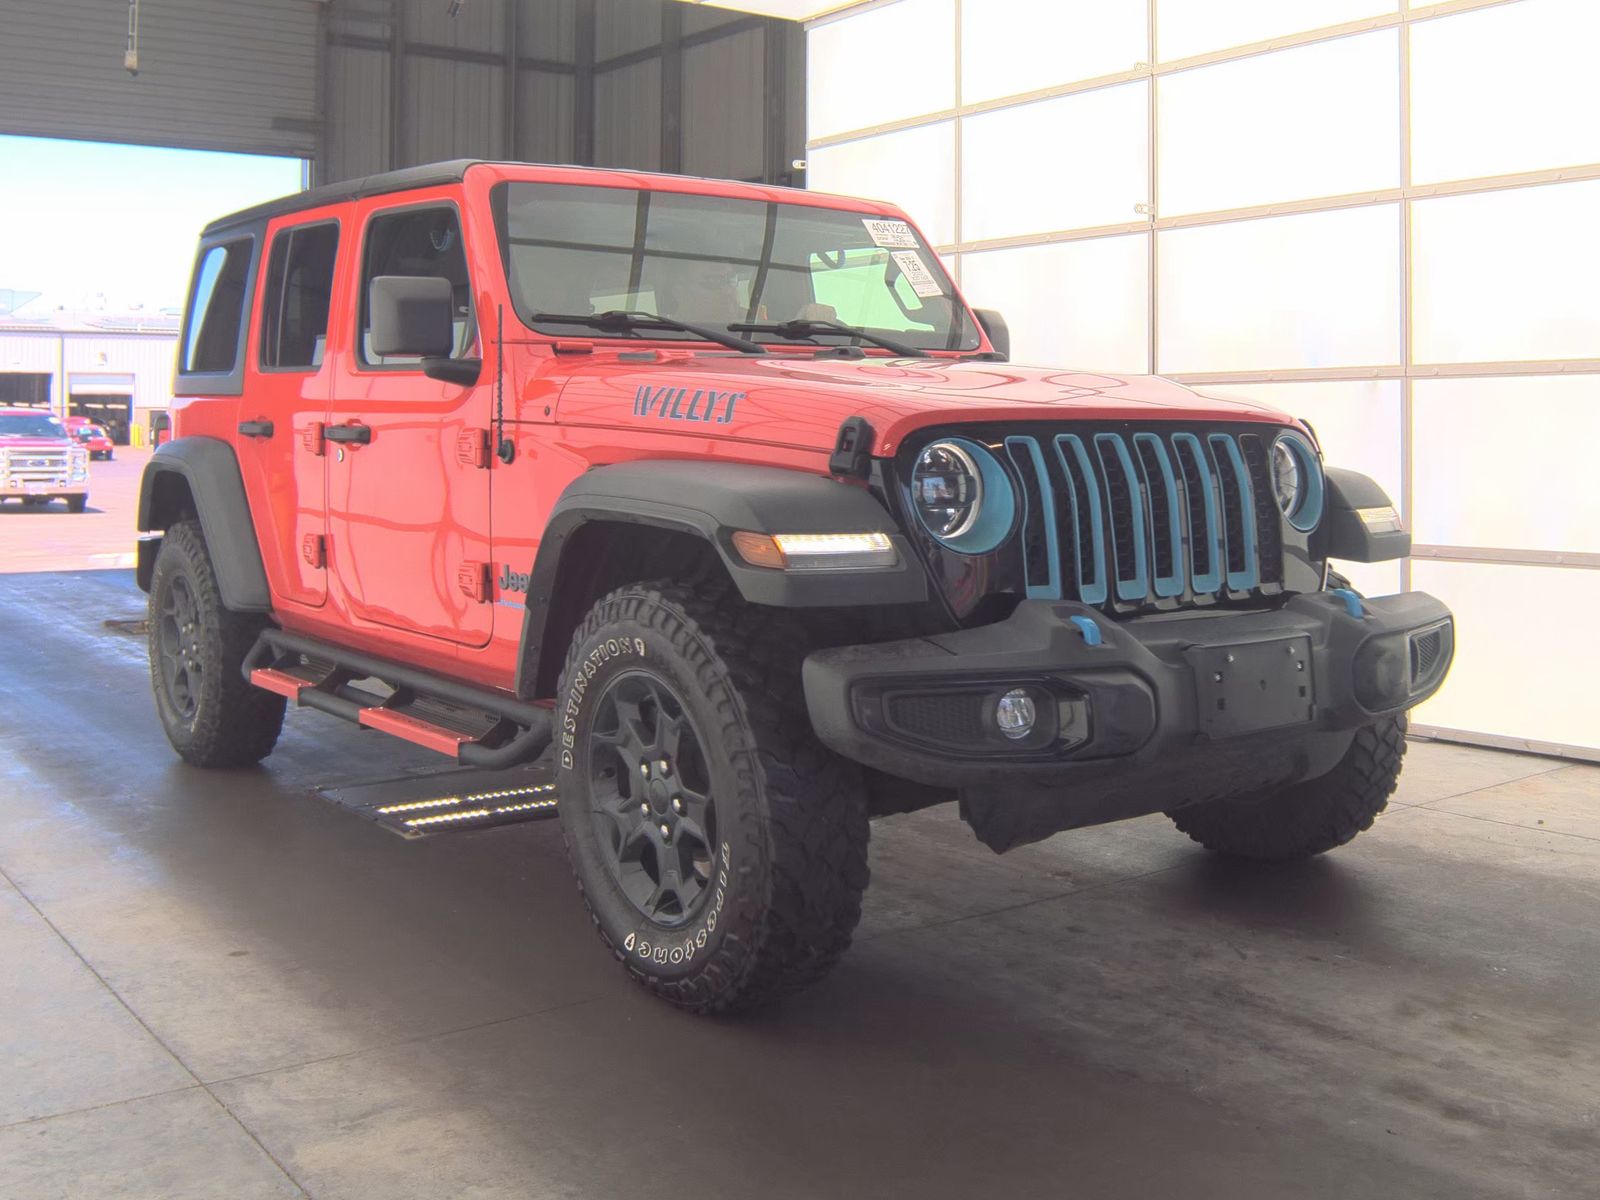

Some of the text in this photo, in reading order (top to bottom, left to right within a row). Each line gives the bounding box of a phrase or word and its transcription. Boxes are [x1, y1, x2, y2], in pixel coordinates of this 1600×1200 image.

[633, 385, 746, 424] WILLYS
[498, 564, 530, 594] Jee
[562, 636, 633, 770] DESTINATION
[638, 841, 730, 964] Firestone
